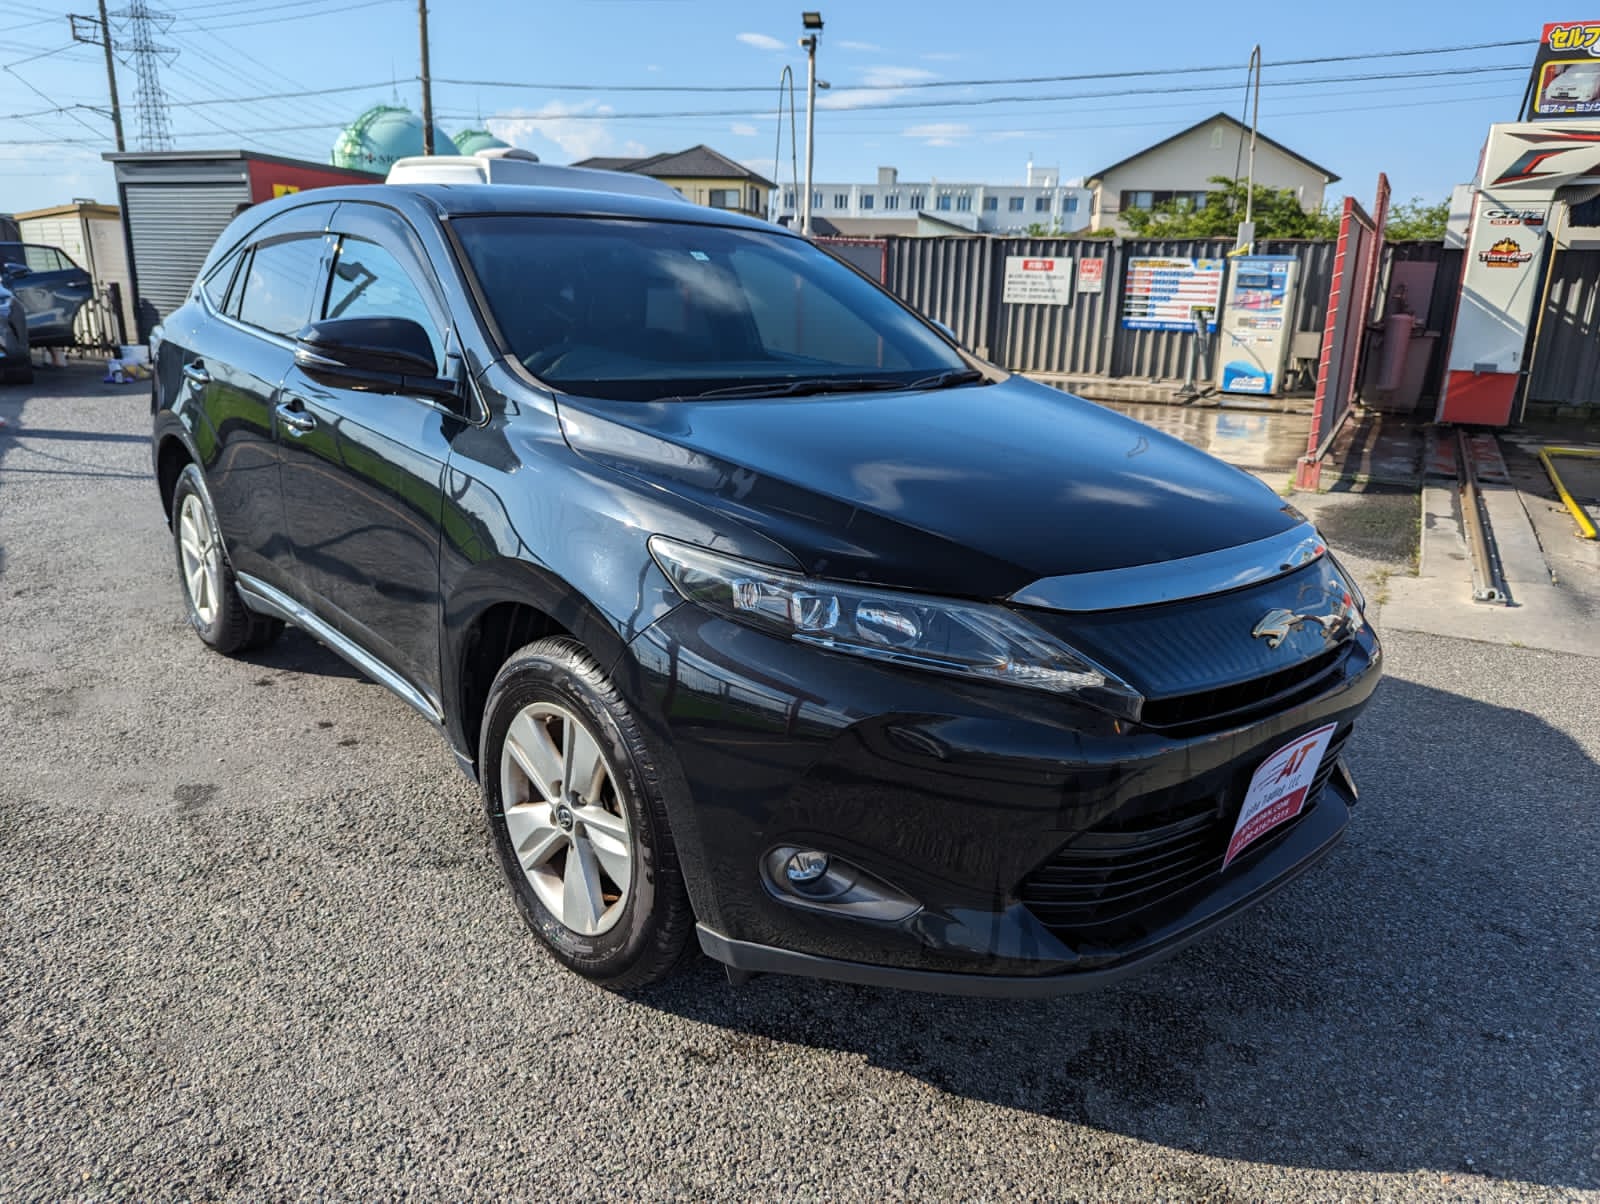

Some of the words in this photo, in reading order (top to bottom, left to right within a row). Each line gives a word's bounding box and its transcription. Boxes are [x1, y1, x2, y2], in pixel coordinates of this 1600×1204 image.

[1551, 26, 1600, 49] セルフ
[1274, 741, 1318, 785] AT
